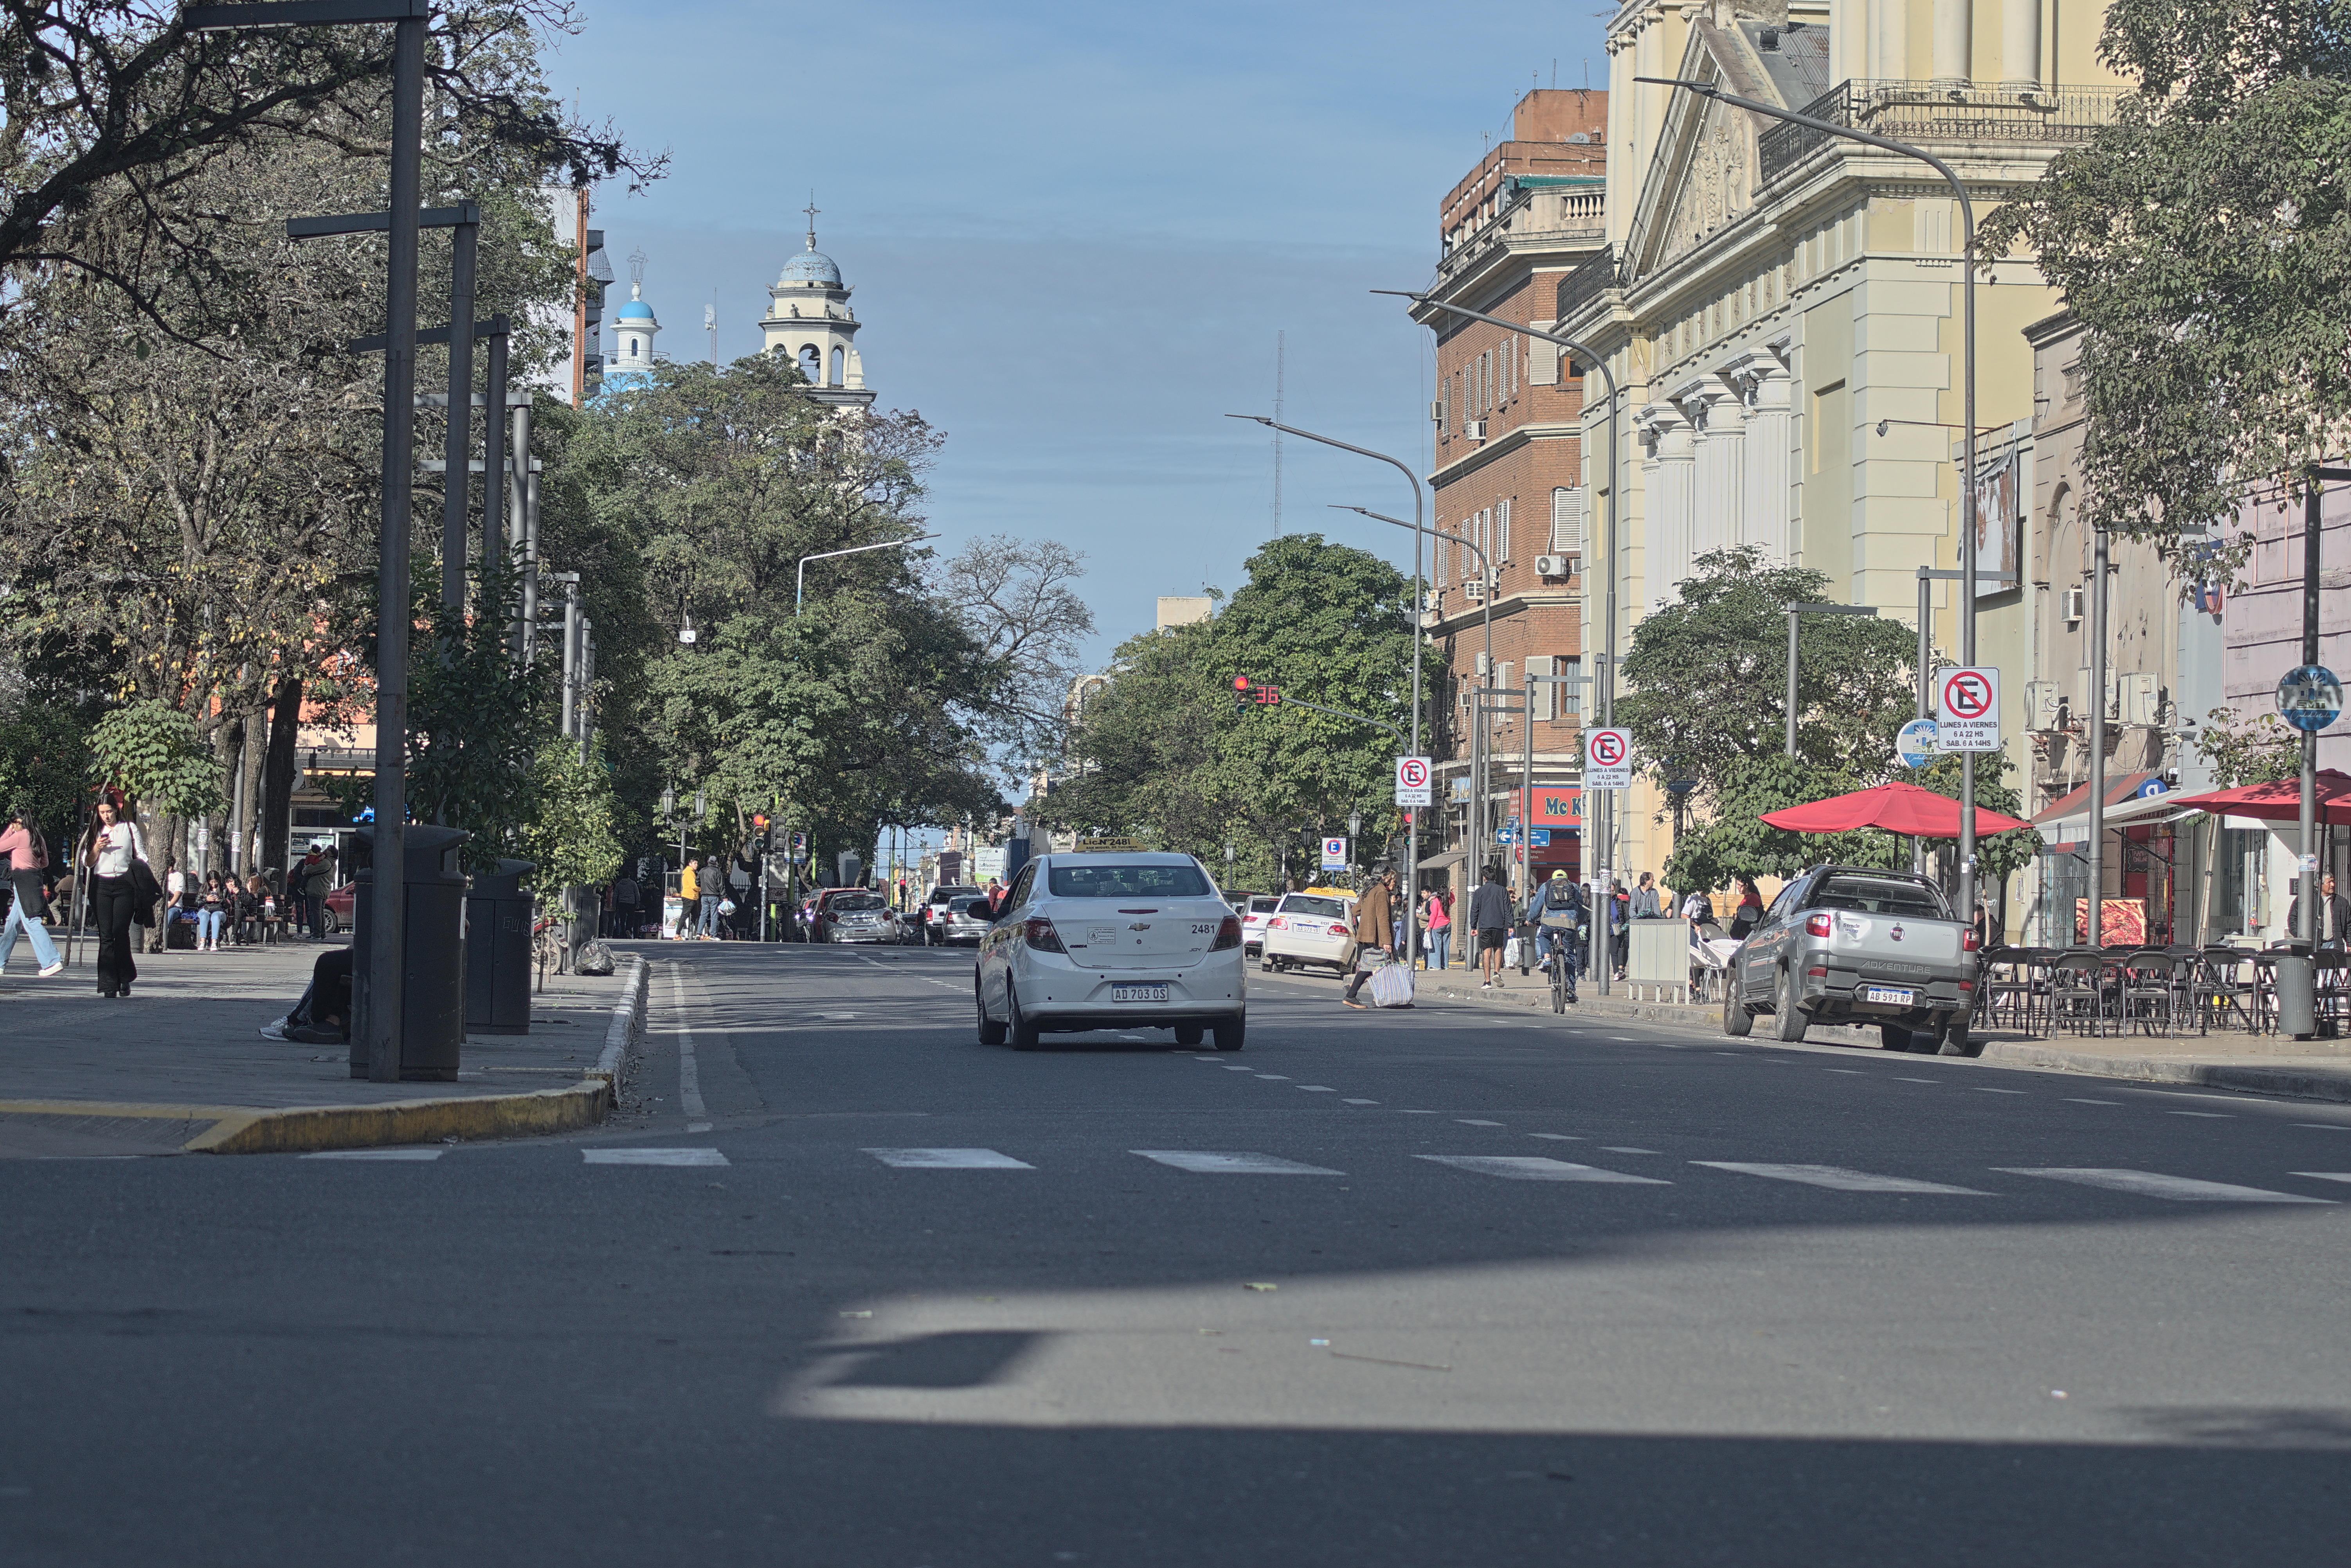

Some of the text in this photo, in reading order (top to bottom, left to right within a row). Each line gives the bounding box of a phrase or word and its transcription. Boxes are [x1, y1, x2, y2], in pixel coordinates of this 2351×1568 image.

[1256, 687, 1278, 703] 36
[1545, 796, 1568, 816] Mc
[1330, 842, 1338, 852] E
[1192, 924, 1215, 934] 2481
[1861, 960, 1931, 974] ADVENTURE
[1115, 989, 1127, 1000] AD
[1131, 989, 1150, 999] 703
[1870, 992, 1911, 1003] AB 591 RP
